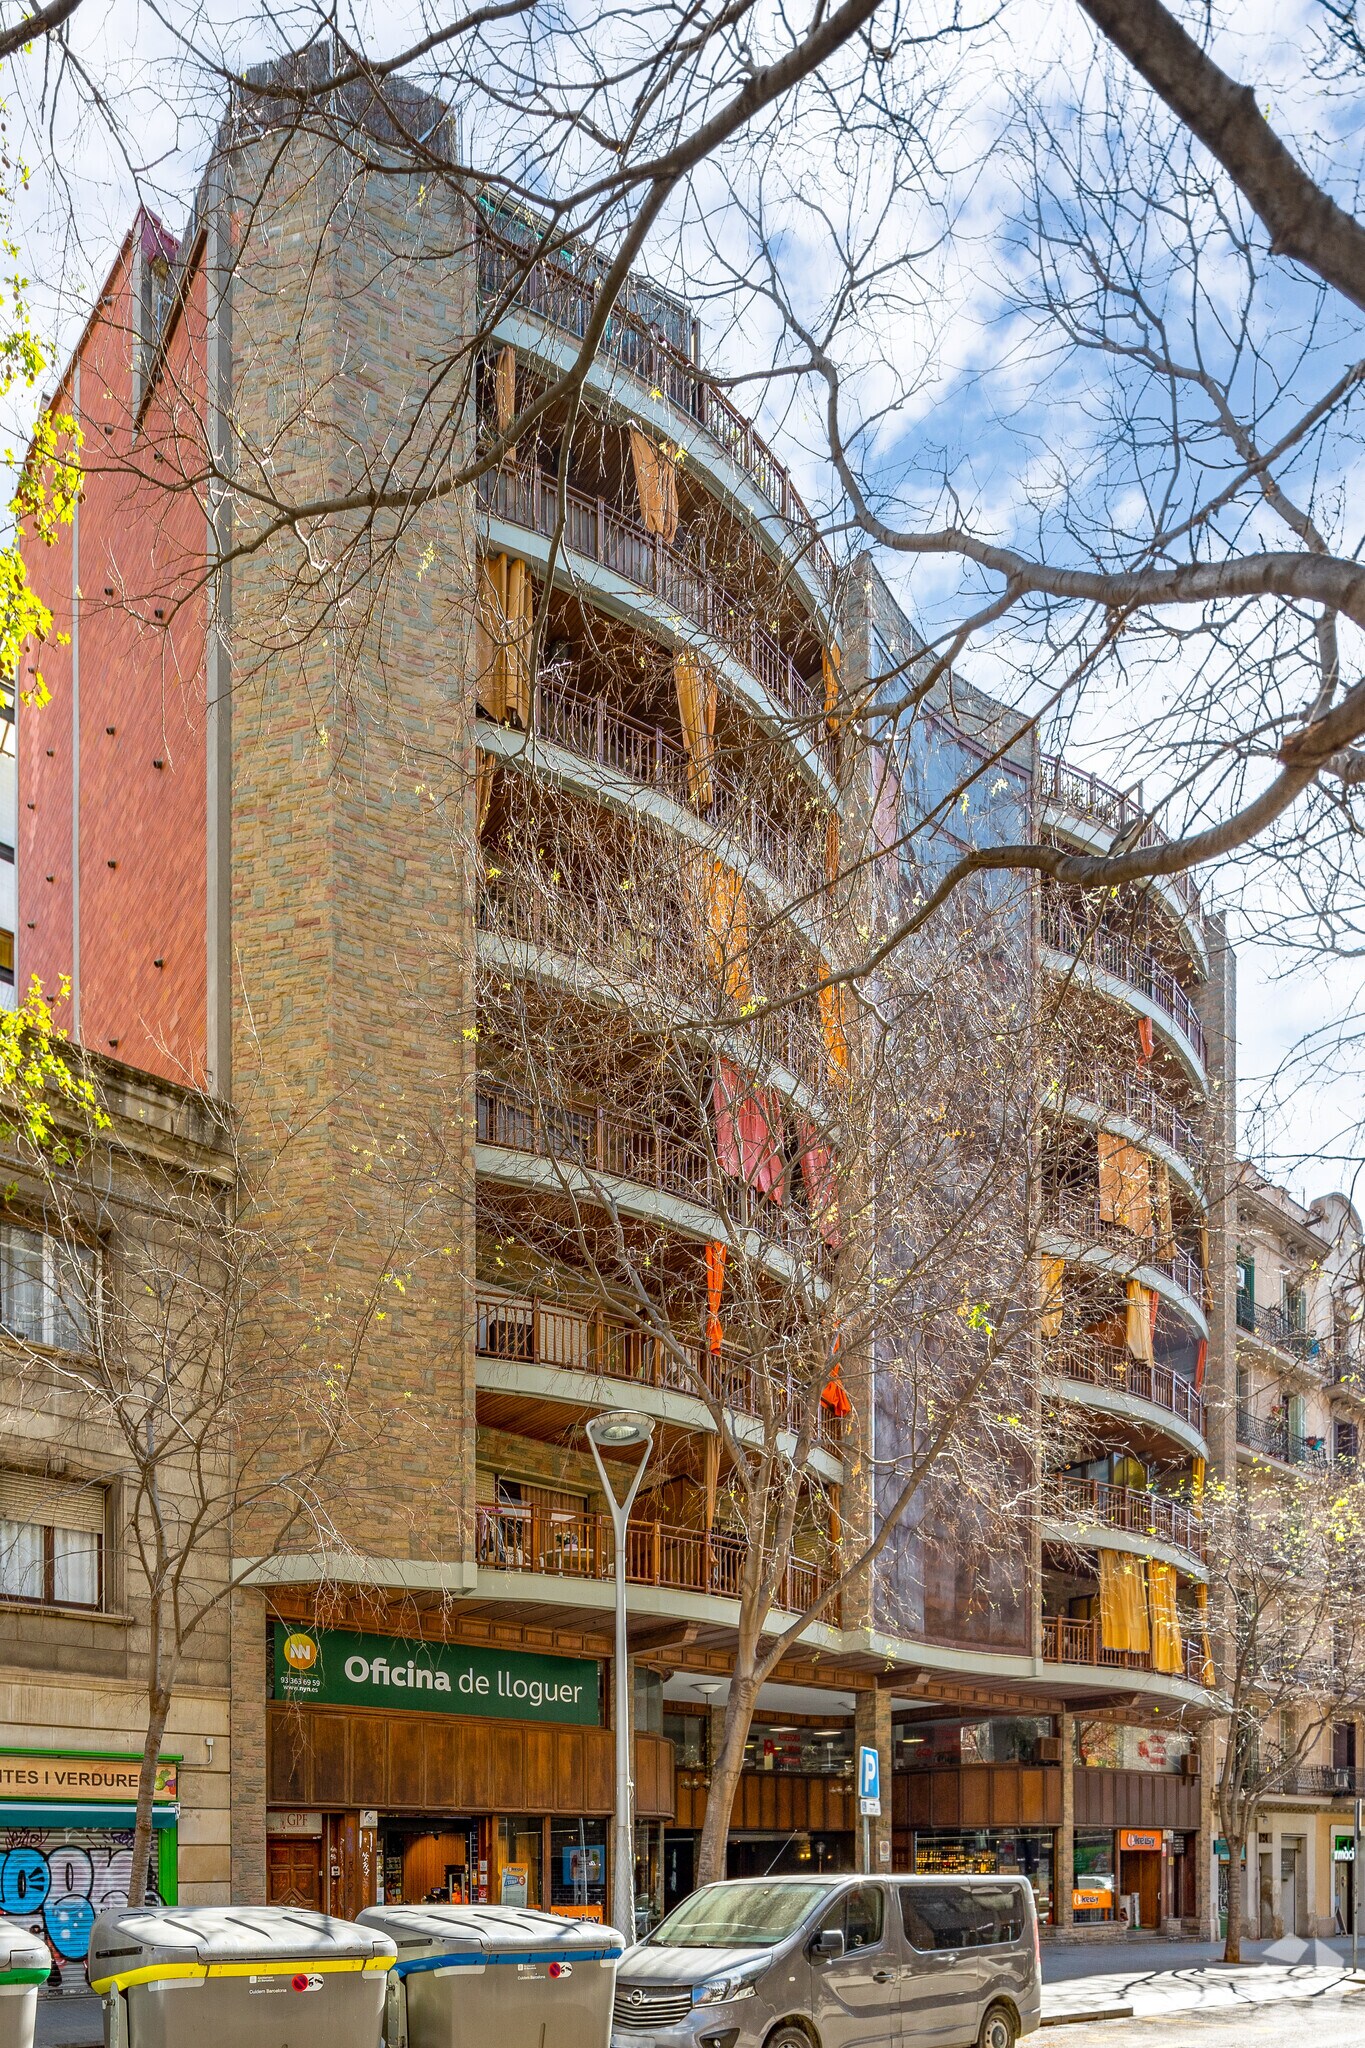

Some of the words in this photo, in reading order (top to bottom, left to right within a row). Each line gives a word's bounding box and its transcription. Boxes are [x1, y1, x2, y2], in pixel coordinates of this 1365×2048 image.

[280, 1676, 289, 1684] 93
[312, 1679, 321, 1687] 59
[344, 1655, 452, 1692] Oficina
[458, 1667, 490, 1694] de
[498, 1670, 583, 1707] lloguer
[45, 1771, 49, 1785] I
[54, 1771, 139, 1788] VERDURE
[864, 1754, 876, 1793] P
